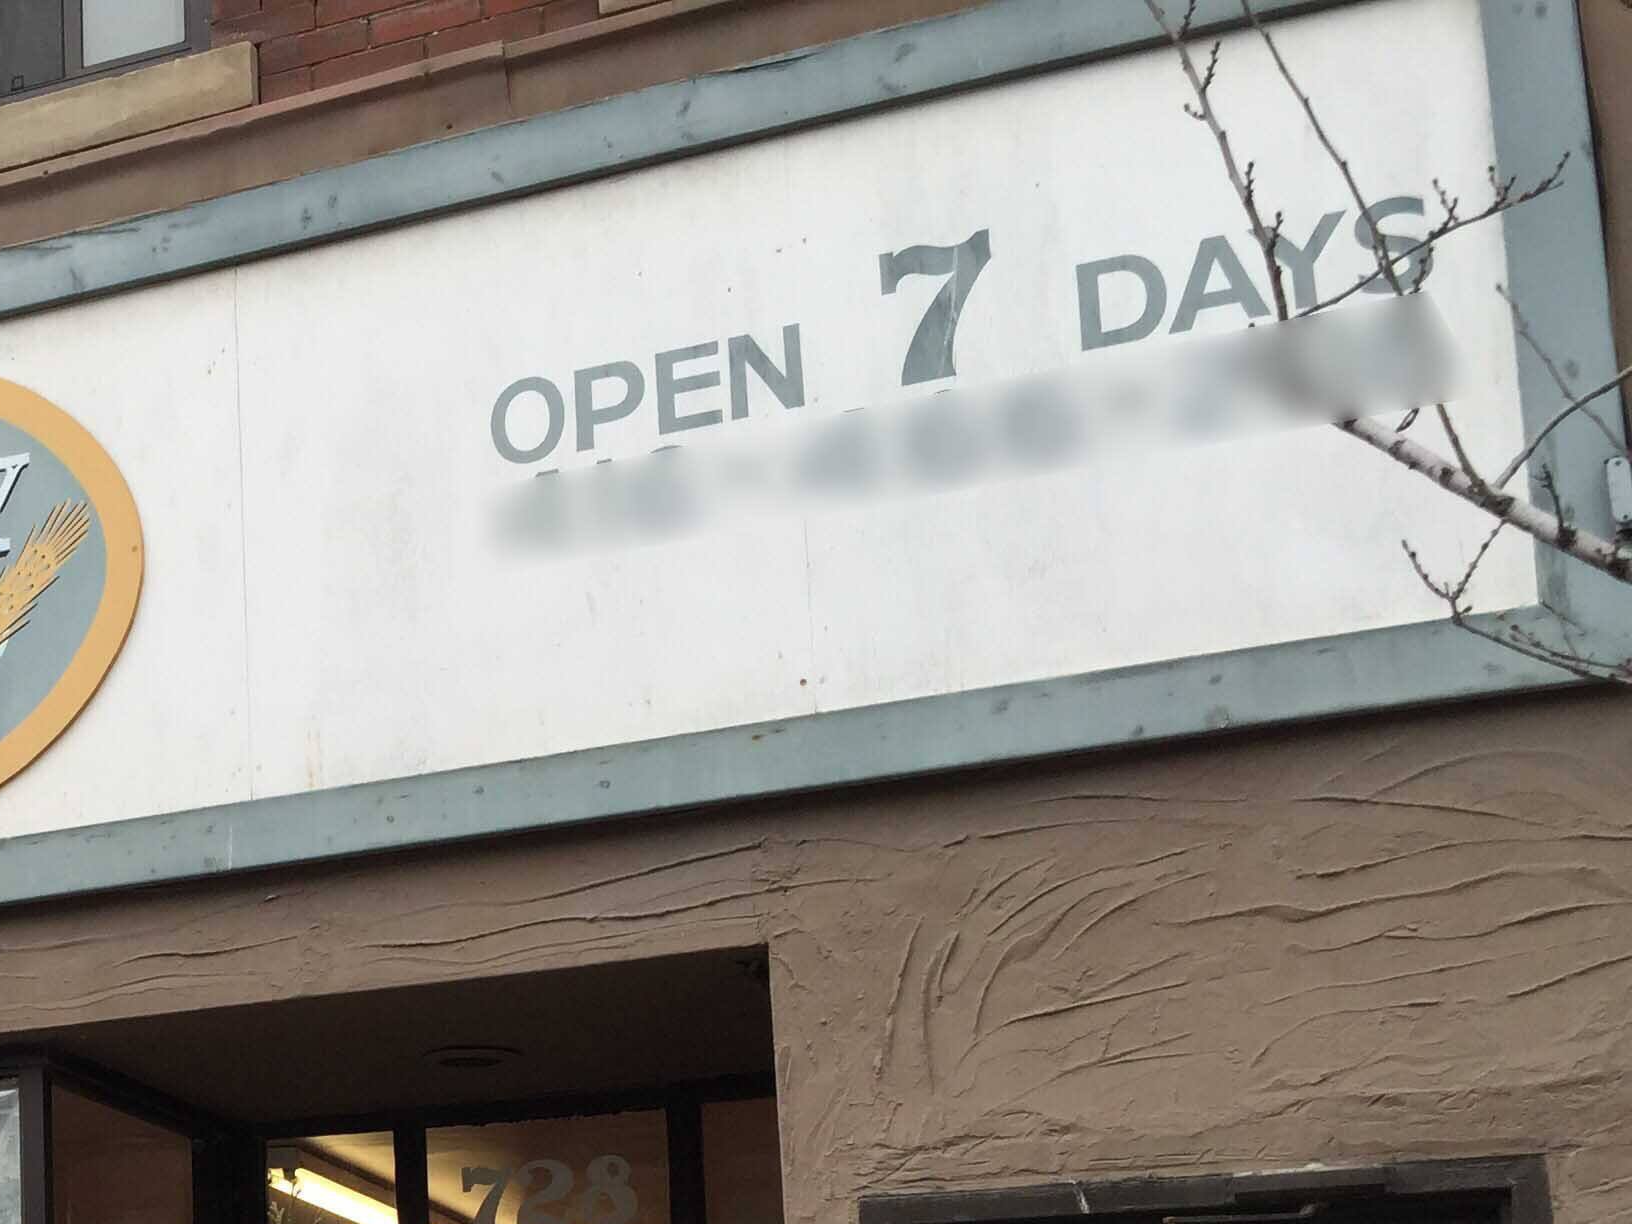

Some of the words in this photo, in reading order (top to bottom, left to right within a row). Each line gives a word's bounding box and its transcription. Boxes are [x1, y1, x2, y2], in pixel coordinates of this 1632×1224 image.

[489, 324, 805, 464] OPEN
[878, 229, 991, 386] 7
[1076, 196, 1433, 353] DAYS
